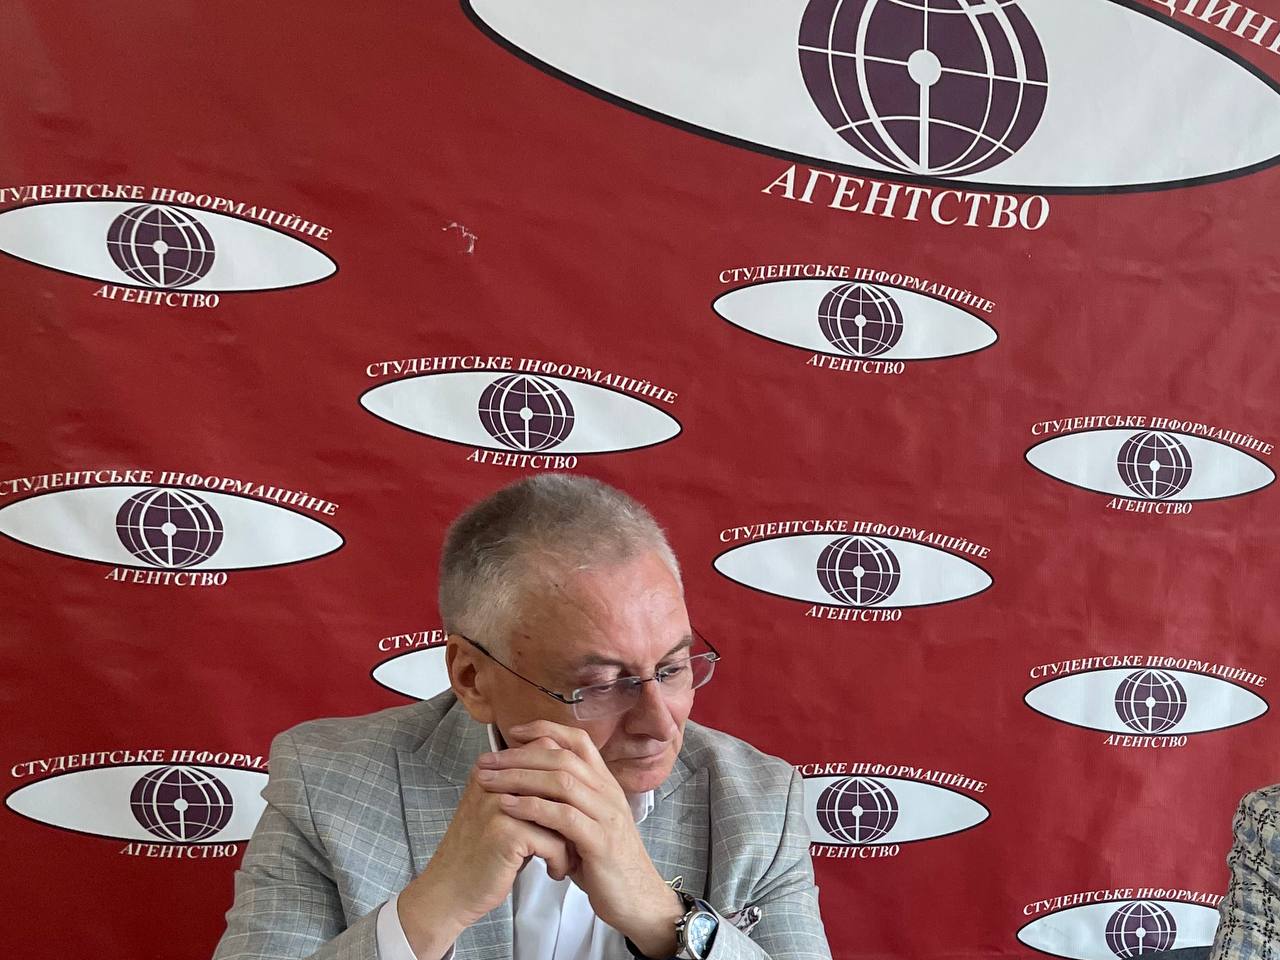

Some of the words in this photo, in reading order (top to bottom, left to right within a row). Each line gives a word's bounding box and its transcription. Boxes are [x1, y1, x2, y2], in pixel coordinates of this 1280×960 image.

[761, 164, 1049, 230] АГЕНТСТВО
[0, 183, 144, 203] ТУДЕНТСЬКЕ
[151, 188, 332, 240] ІНФОРМАЦІЙНЕ
[94, 285, 219, 307] АГЕНТСТВО
[719, 265, 850, 283] СТУДЕНТСЬКЕ
[854, 268, 995, 313] ІНФОРМАЦІЙНЕ
[807, 354, 905, 374] АГЕНТСТВО
[367, 356, 513, 377] СТУДЕНТСЬКЕ
[518, 359, 677, 403] ІНФОРМАЦІЙНЕ
[1032, 416, 1146, 435] СТУДЕНТСЬКЕ
[1150, 417, 1274, 455] ІНФОРМАЦІЙНЕ
[467, 449, 577, 468] АГЕНТСТВО
[0, 470, 153, 495] СТУДЕНТСЬКЕ
[159, 472, 338, 515] ІНФОРМАЦІЙНЕ
[1107, 498, 1192, 514] АГЕНТСТВО
[720, 520, 848, 542] СТУДЕНТСЬКЕ
[852, 521, 990, 558] ІНФОРМАЦІЙНЕ
[104, 568, 228, 587] АГЕНТСТВО
[805, 605, 903, 622] АГЕНТСТВО
[1030, 656, 1143, 678] СТУДЕНТСЬКЕ
[1145, 656, 1264, 687] ІНФОРМАЦІЙНЕ
[1104, 734, 1187, 748] АГЕНТСТВО
[12, 750, 165, 777] СТУДЕНТСЬКЕ
[851, 763, 987, 792] ІНФОРМАЦІЙНЕ
[119, 843, 238, 859] АГЕНТСТВО
[809, 844, 900, 859] АГЕНТСТВО
[1023, 888, 1133, 916] СТУДЕНТСЬКЕ
